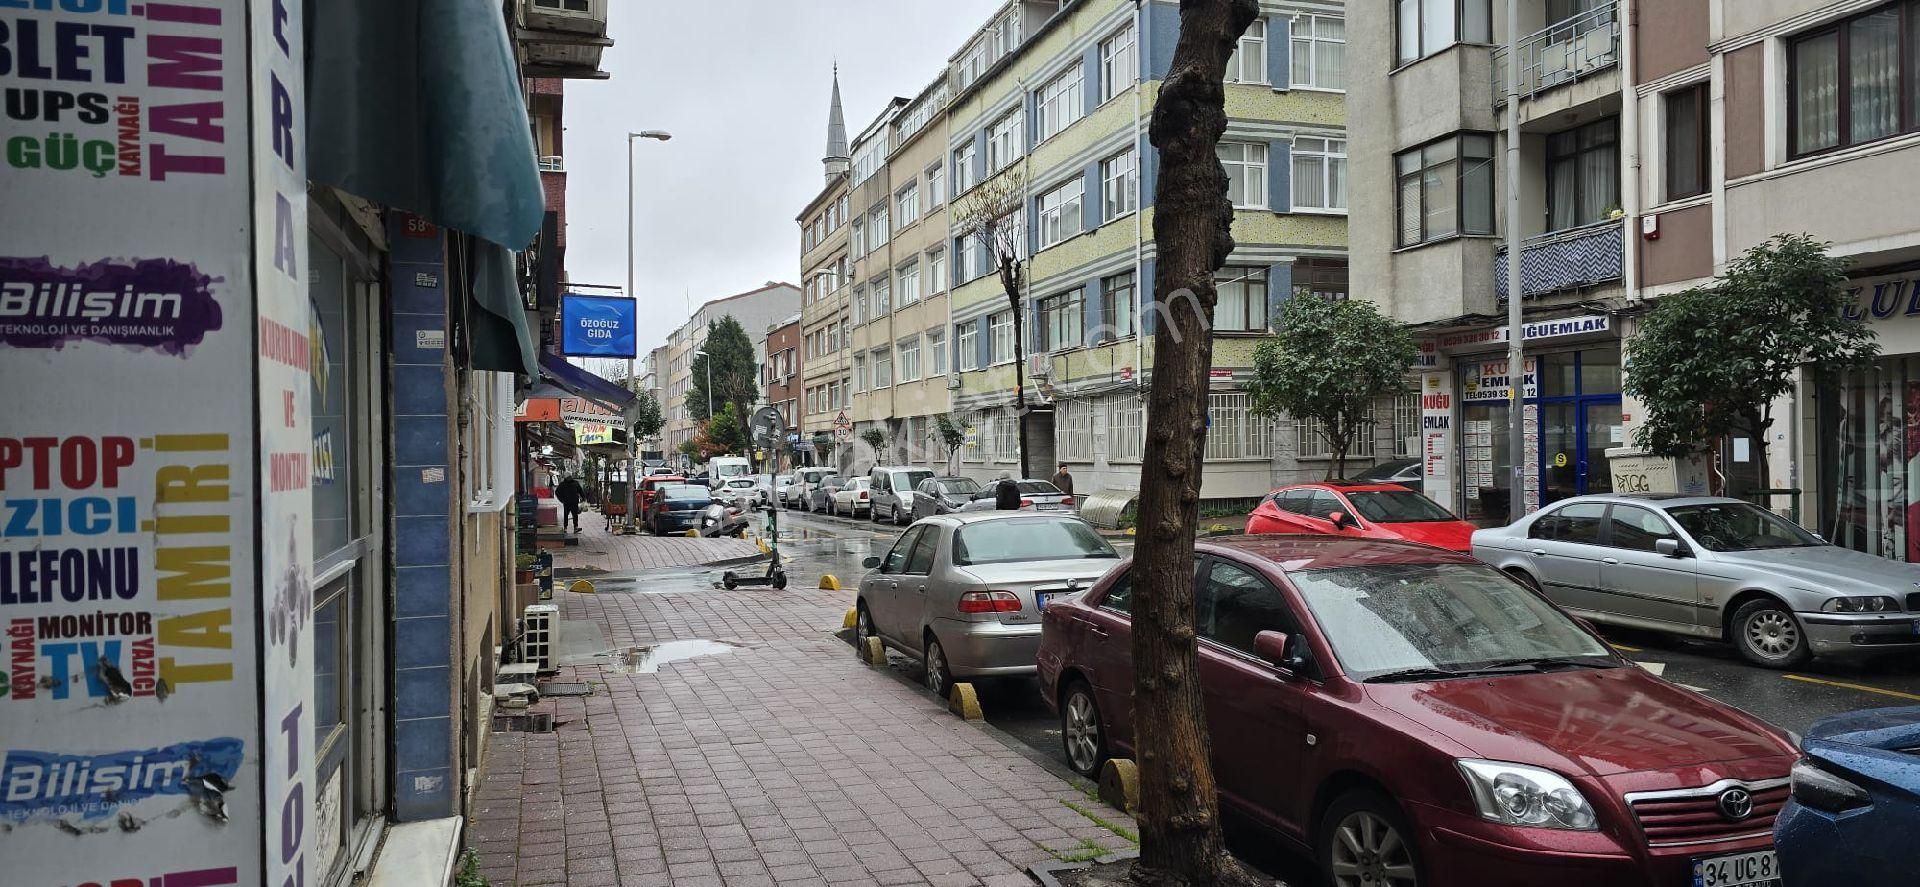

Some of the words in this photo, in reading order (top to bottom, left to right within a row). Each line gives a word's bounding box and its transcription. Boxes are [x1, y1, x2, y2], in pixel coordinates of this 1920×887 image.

[6, 88, 109, 124] UPS
[112, 96, 141, 176] KAYNAĞI
[7, 132, 116, 178] GÜÇ
[0, 282, 182, 322] Bilişim
[71, 325, 87, 335] VE
[91, 325, 175, 337] DANIŞMANLIK
[580, 317, 620, 329] ÖZOĞUZ
[587, 328, 613, 339] GIDA
[1505, 317, 1606, 341] ĞUEMLAK
[1483, 360, 1535, 376] KUU
[283, 389, 296, 428] VE
[1423, 391, 1450, 410] KUĞU
[1526, 388, 1537, 397] 12
[1423, 415, 1450, 429] EMLAK
[0, 496, 137, 538] ZICI
[0, 546, 139, 605] LEFONU
[140, 433, 234, 694] TAMİRİ
[38, 611, 152, 640] MONİTOR
[6, 618, 36, 700] KAYNAĞI
[41, 640, 122, 700] TV
[132, 636, 156, 698] YAZICI
[1705, 863, 1729, 886] 34
[1735, 856, 1757, 881] UC
